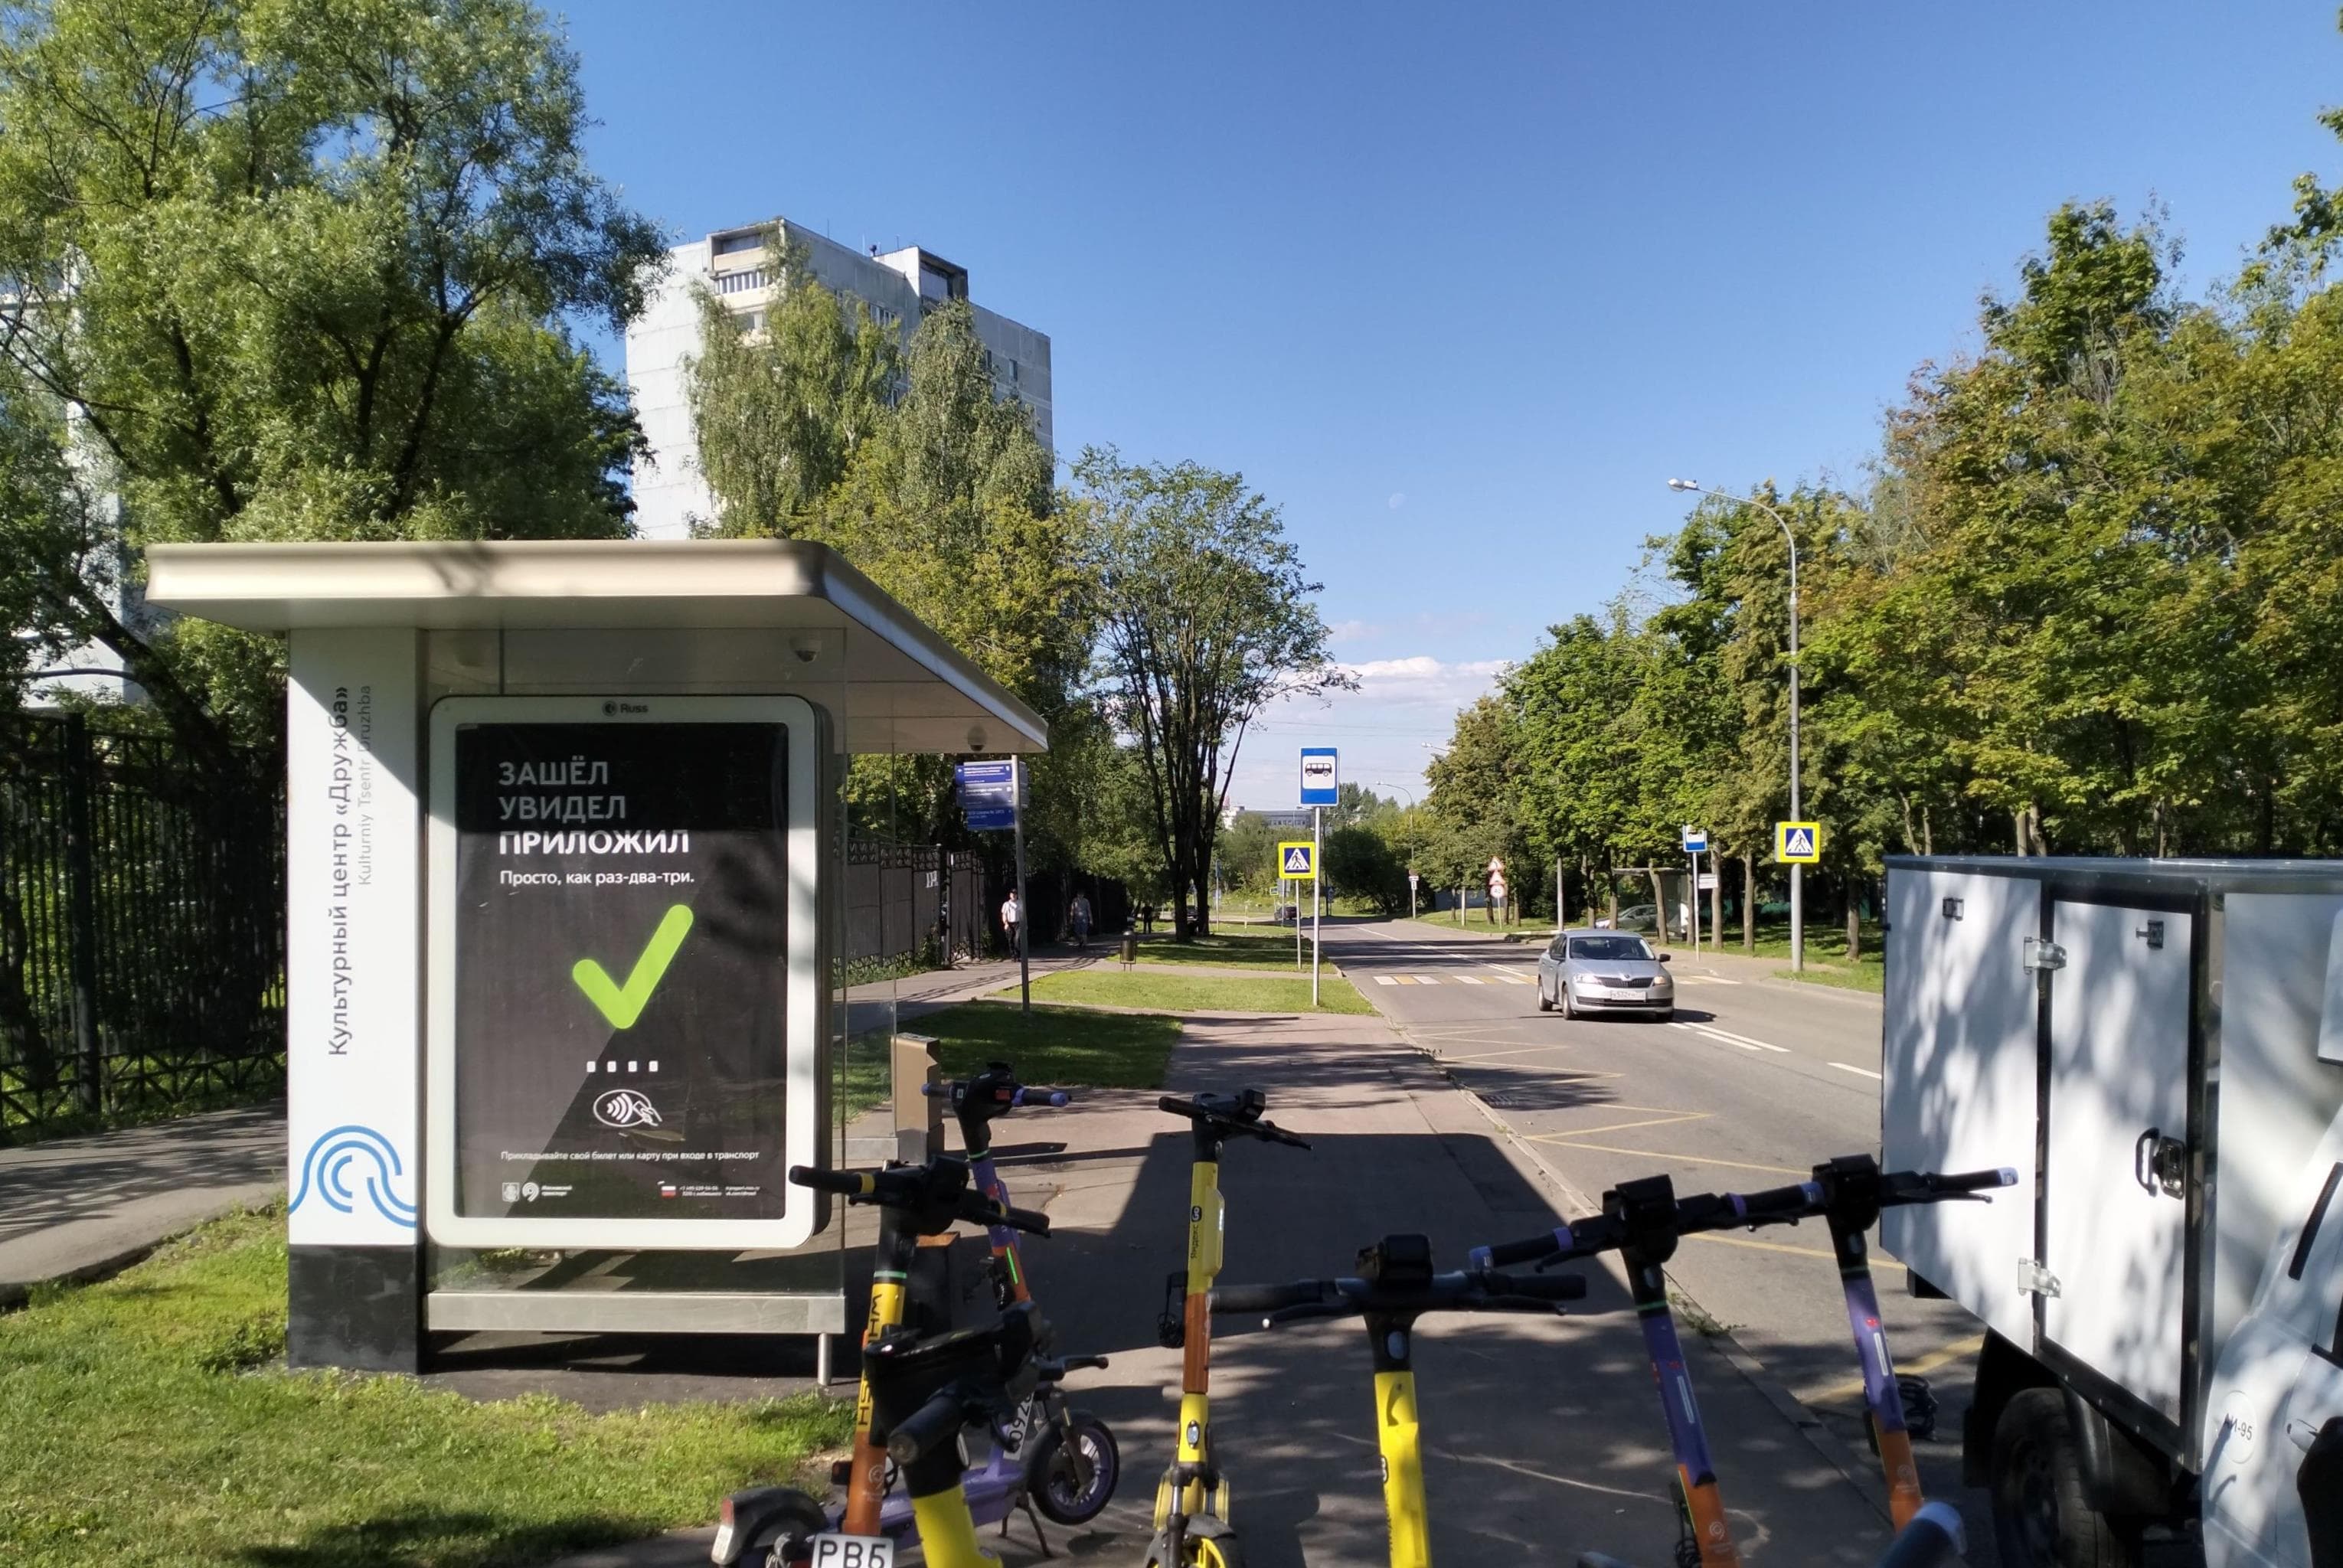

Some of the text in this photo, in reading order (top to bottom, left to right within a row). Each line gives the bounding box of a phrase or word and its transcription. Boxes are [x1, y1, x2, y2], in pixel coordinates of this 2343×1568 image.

[620, 703, 649, 714] Russ
[358, 685, 374, 885] Kulturniy Tsentr Druzhba
[498, 756, 609, 786] ЗАШЁЛ
[498, 795, 626, 824] УВИДЕЛ
[499, 829, 690, 854] ПРИЛОЖИЛ
[327, 686, 353, 1056] Культурный центр «Дружба»
[500, 870, 695, 887] Просто, как раз-два-три.
[570, 1152, 590, 1160] свой
[591, 1151, 616, 1160] билет
[636, 1152, 660, 1161] карту
[662, 1152, 678, 1161] при
[714, 1152, 760, 1161] транспорт
[858, 1294, 882, 1425] WHSH
